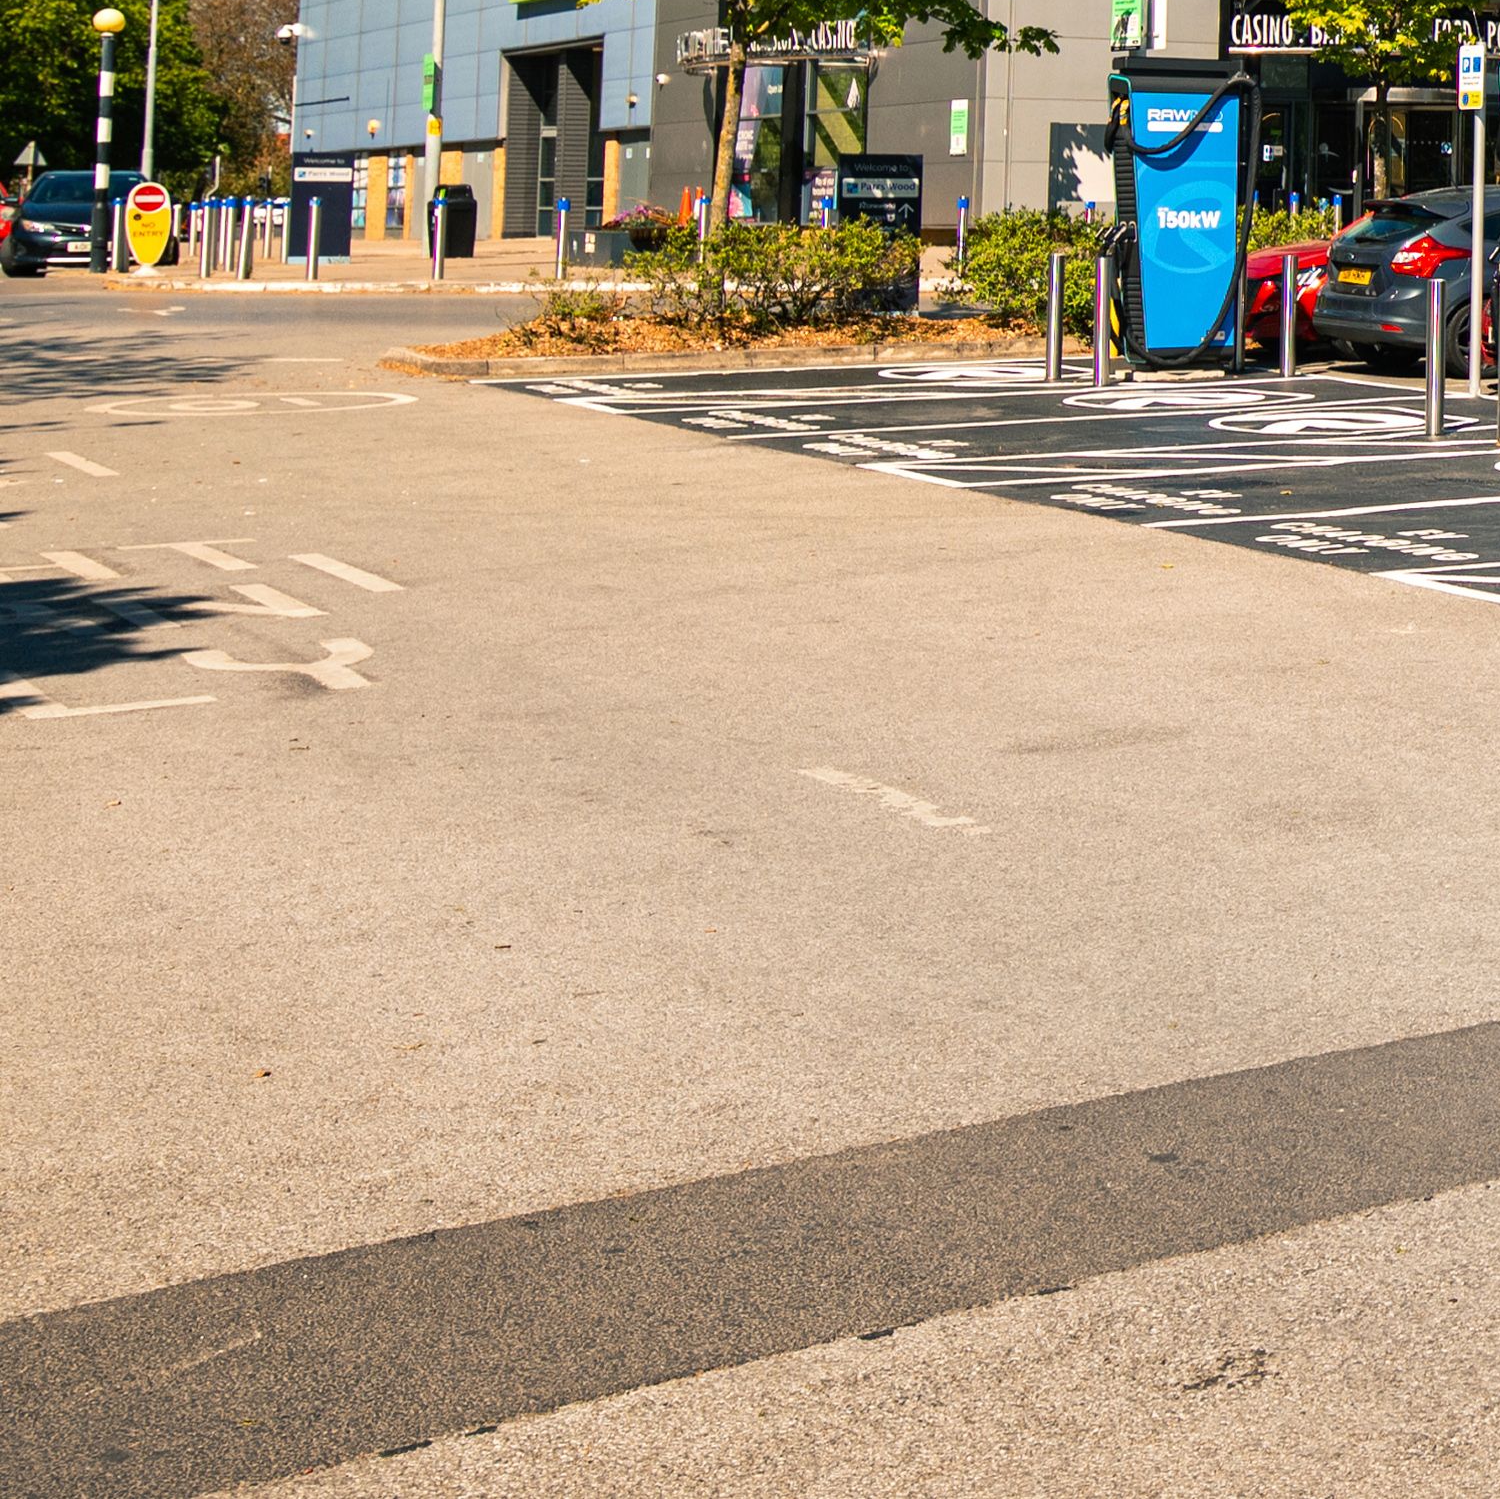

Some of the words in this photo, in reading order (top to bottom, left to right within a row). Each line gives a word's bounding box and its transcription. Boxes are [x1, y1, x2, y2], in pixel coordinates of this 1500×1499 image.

[1231, 14, 1293, 45] CASINO
[854, 163, 897, 172] Welcome
[861, 183, 885, 191] Parrs
[890, 183, 916, 191] Wood
[1157, 210, 1221, 229] 150kW
